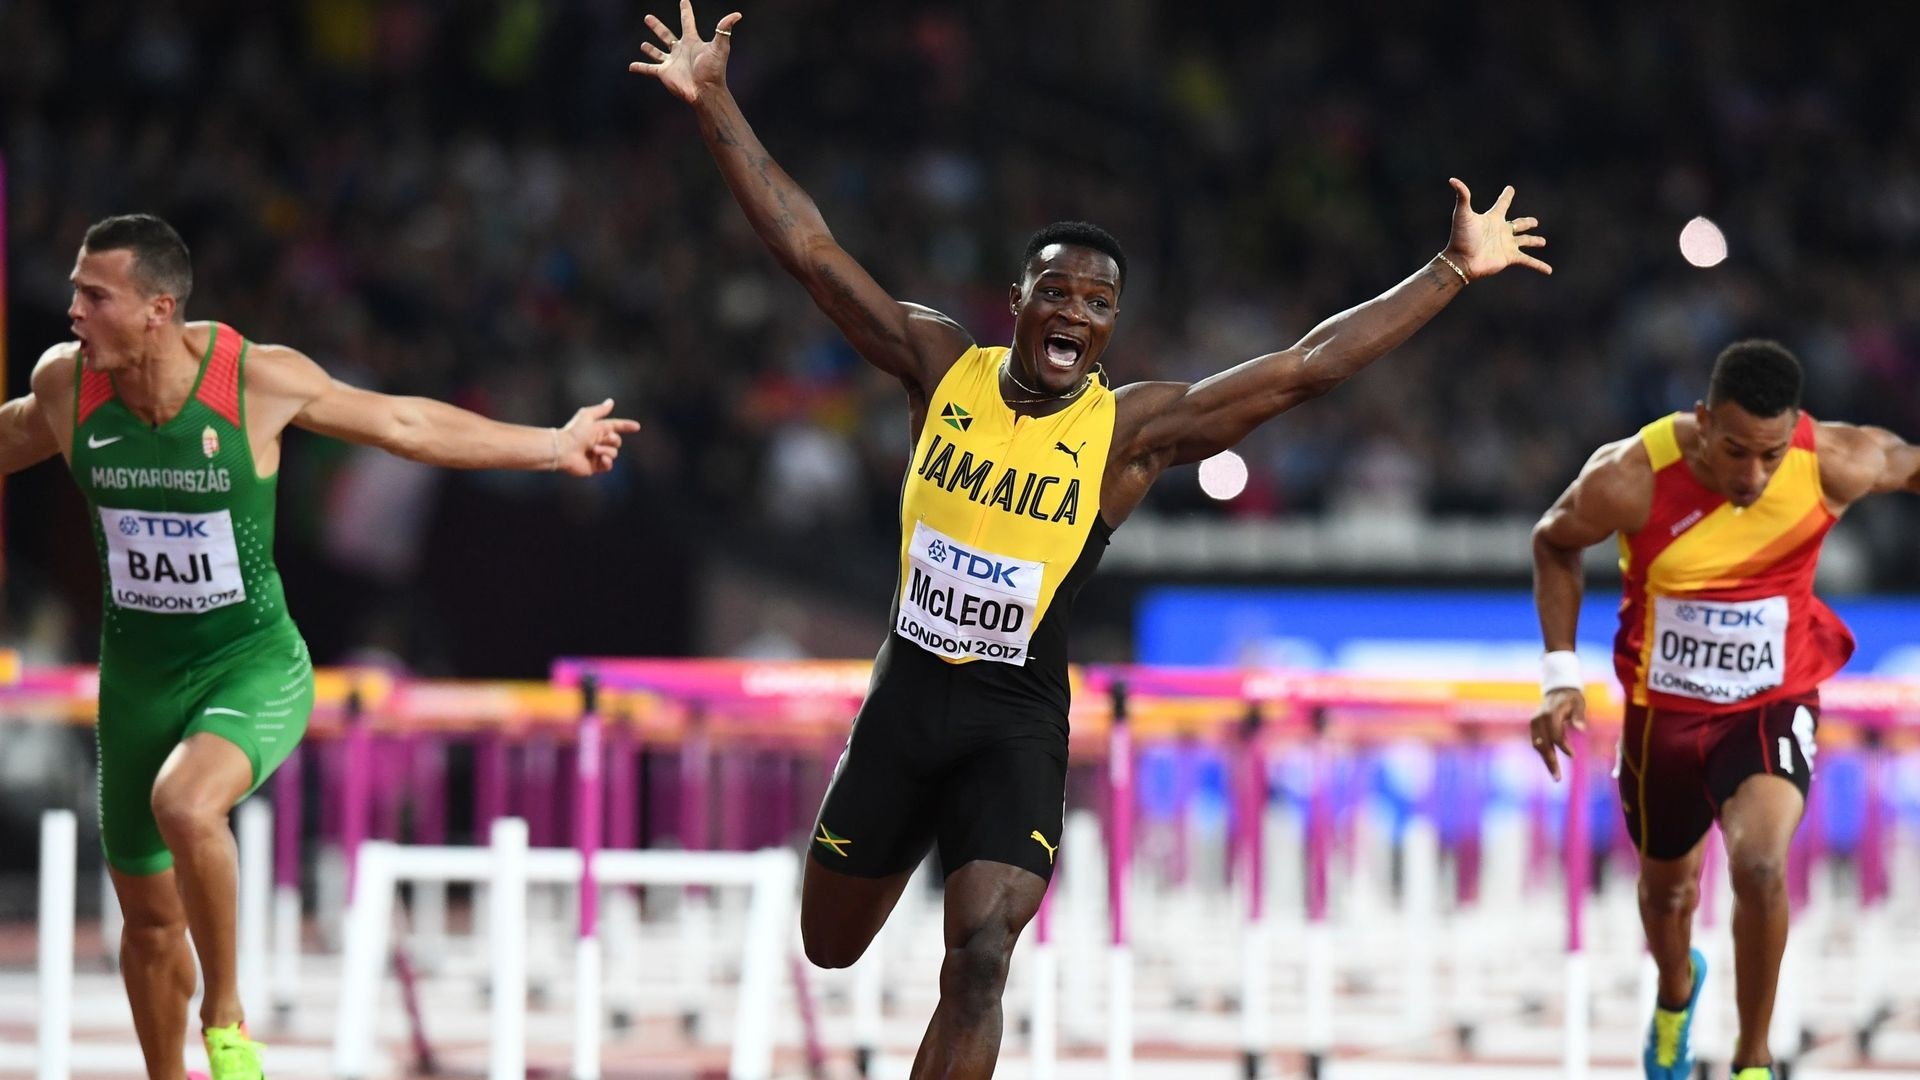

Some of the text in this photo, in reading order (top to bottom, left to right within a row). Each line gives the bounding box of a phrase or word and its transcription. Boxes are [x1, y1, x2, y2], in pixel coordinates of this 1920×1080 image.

[92, 463, 231, 492] MAGYARORSZÁG
[918, 435, 1080, 525] JAMAICA
[138, 516, 209, 538] TDK
[128, 549, 213, 584] BAJI
[948, 545, 1020, 588] TDK
[118, 589, 193, 610] LONDON
[909, 567, 1023, 633] McLEOD
[1698, 605, 1765, 627] TDK
[900, 616, 1021, 660] LONDON 2017
[1661, 630, 1774, 673] ORTEGA
[1653, 671, 1730, 697] LONDON
